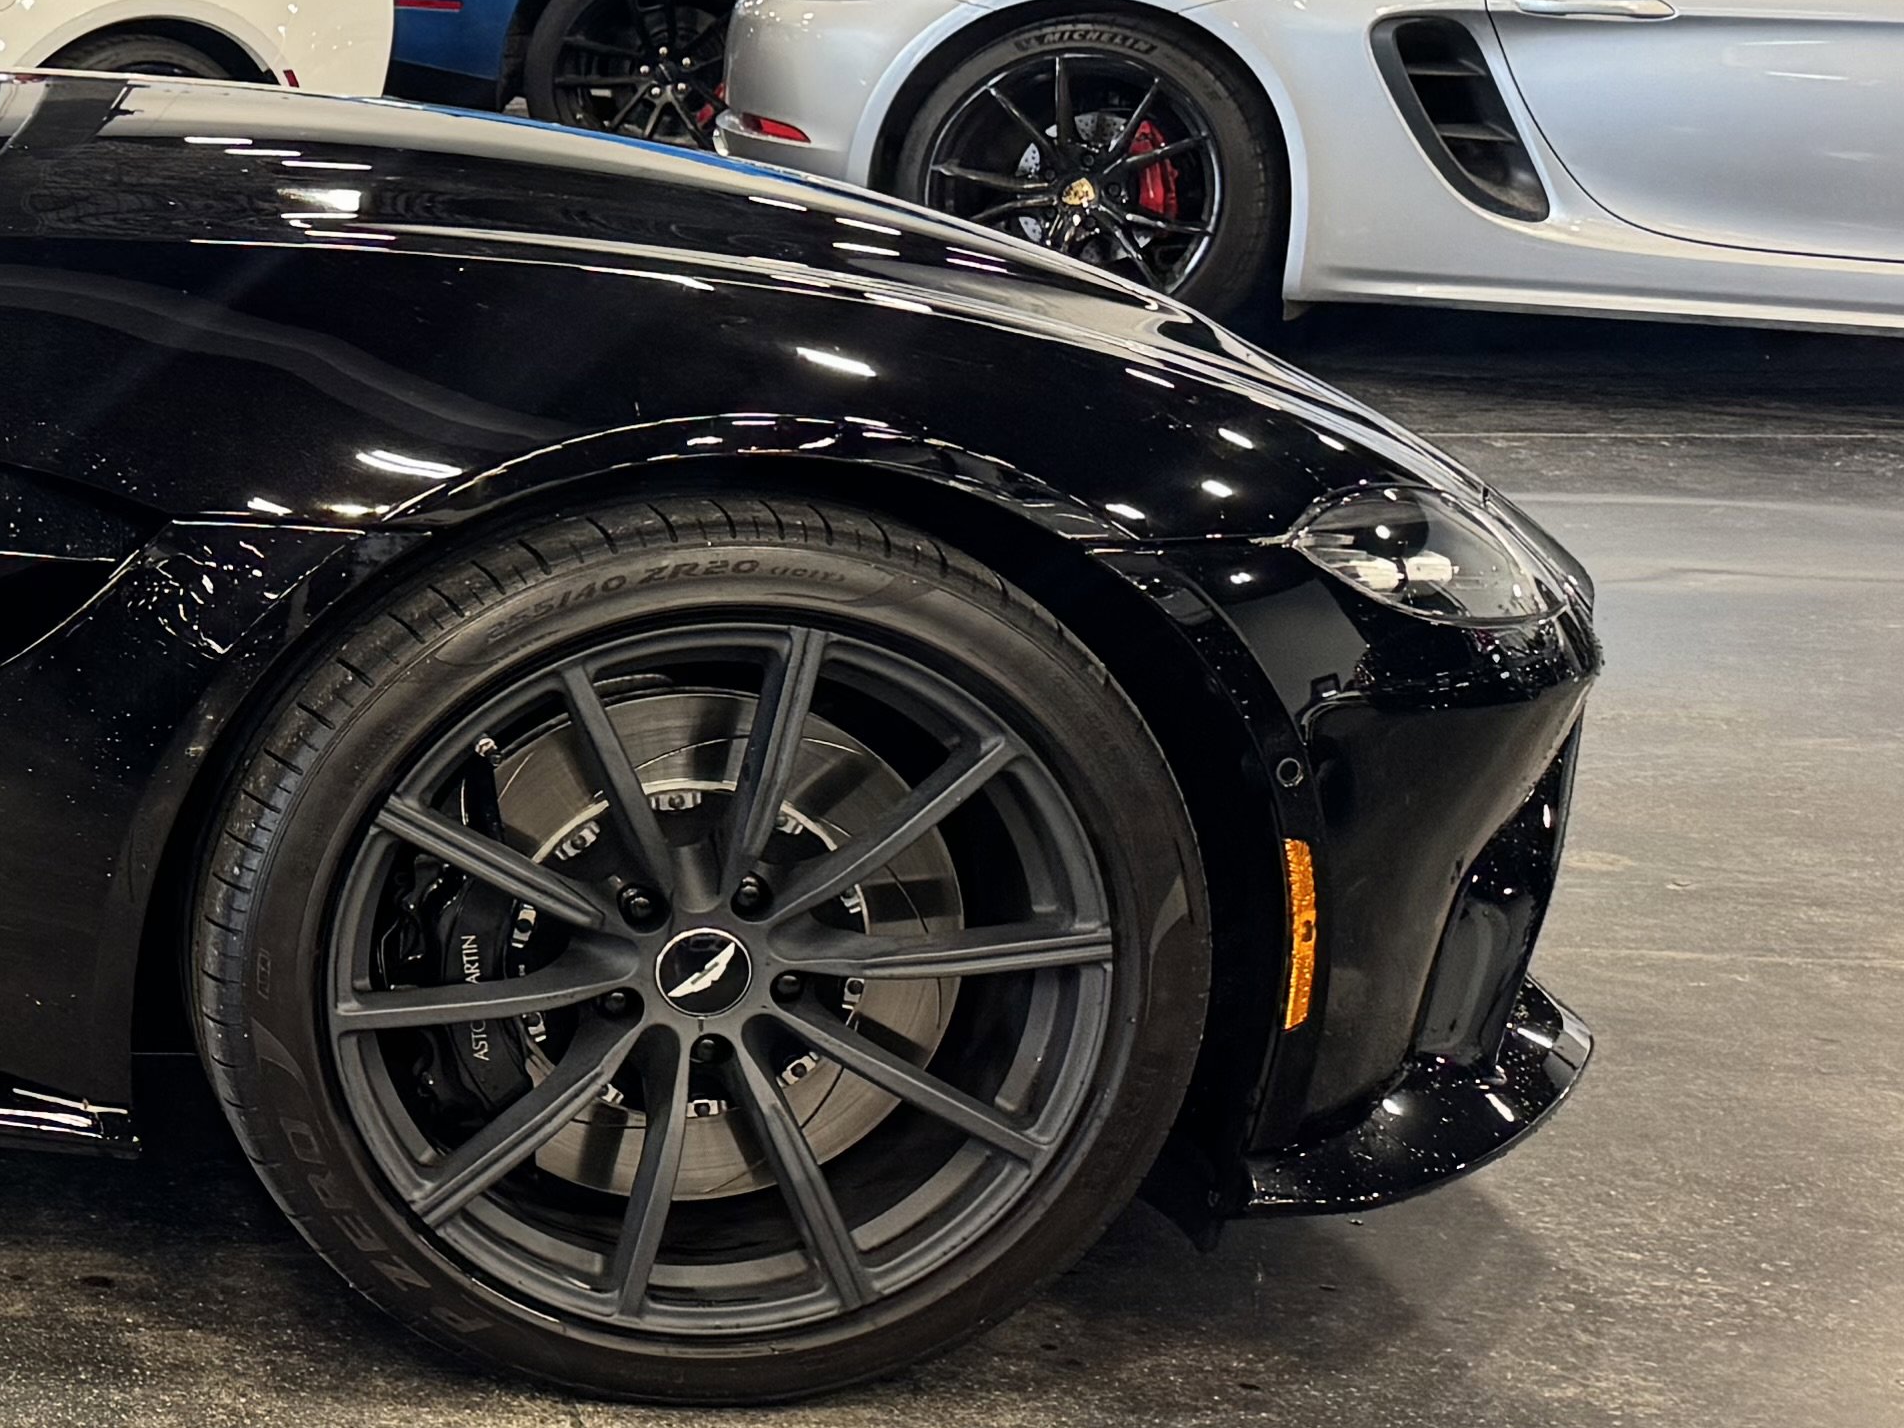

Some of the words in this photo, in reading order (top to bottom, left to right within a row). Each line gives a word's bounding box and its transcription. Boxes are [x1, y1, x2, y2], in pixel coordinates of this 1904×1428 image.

[1043, 30, 1157, 54] MICHELIN
[641, 559, 760, 586] ZR20
[460, 934, 482, 985] ARTIN
[469, 1019, 491, 1062] ASTO
[278, 1116, 433, 1293] ZERO
